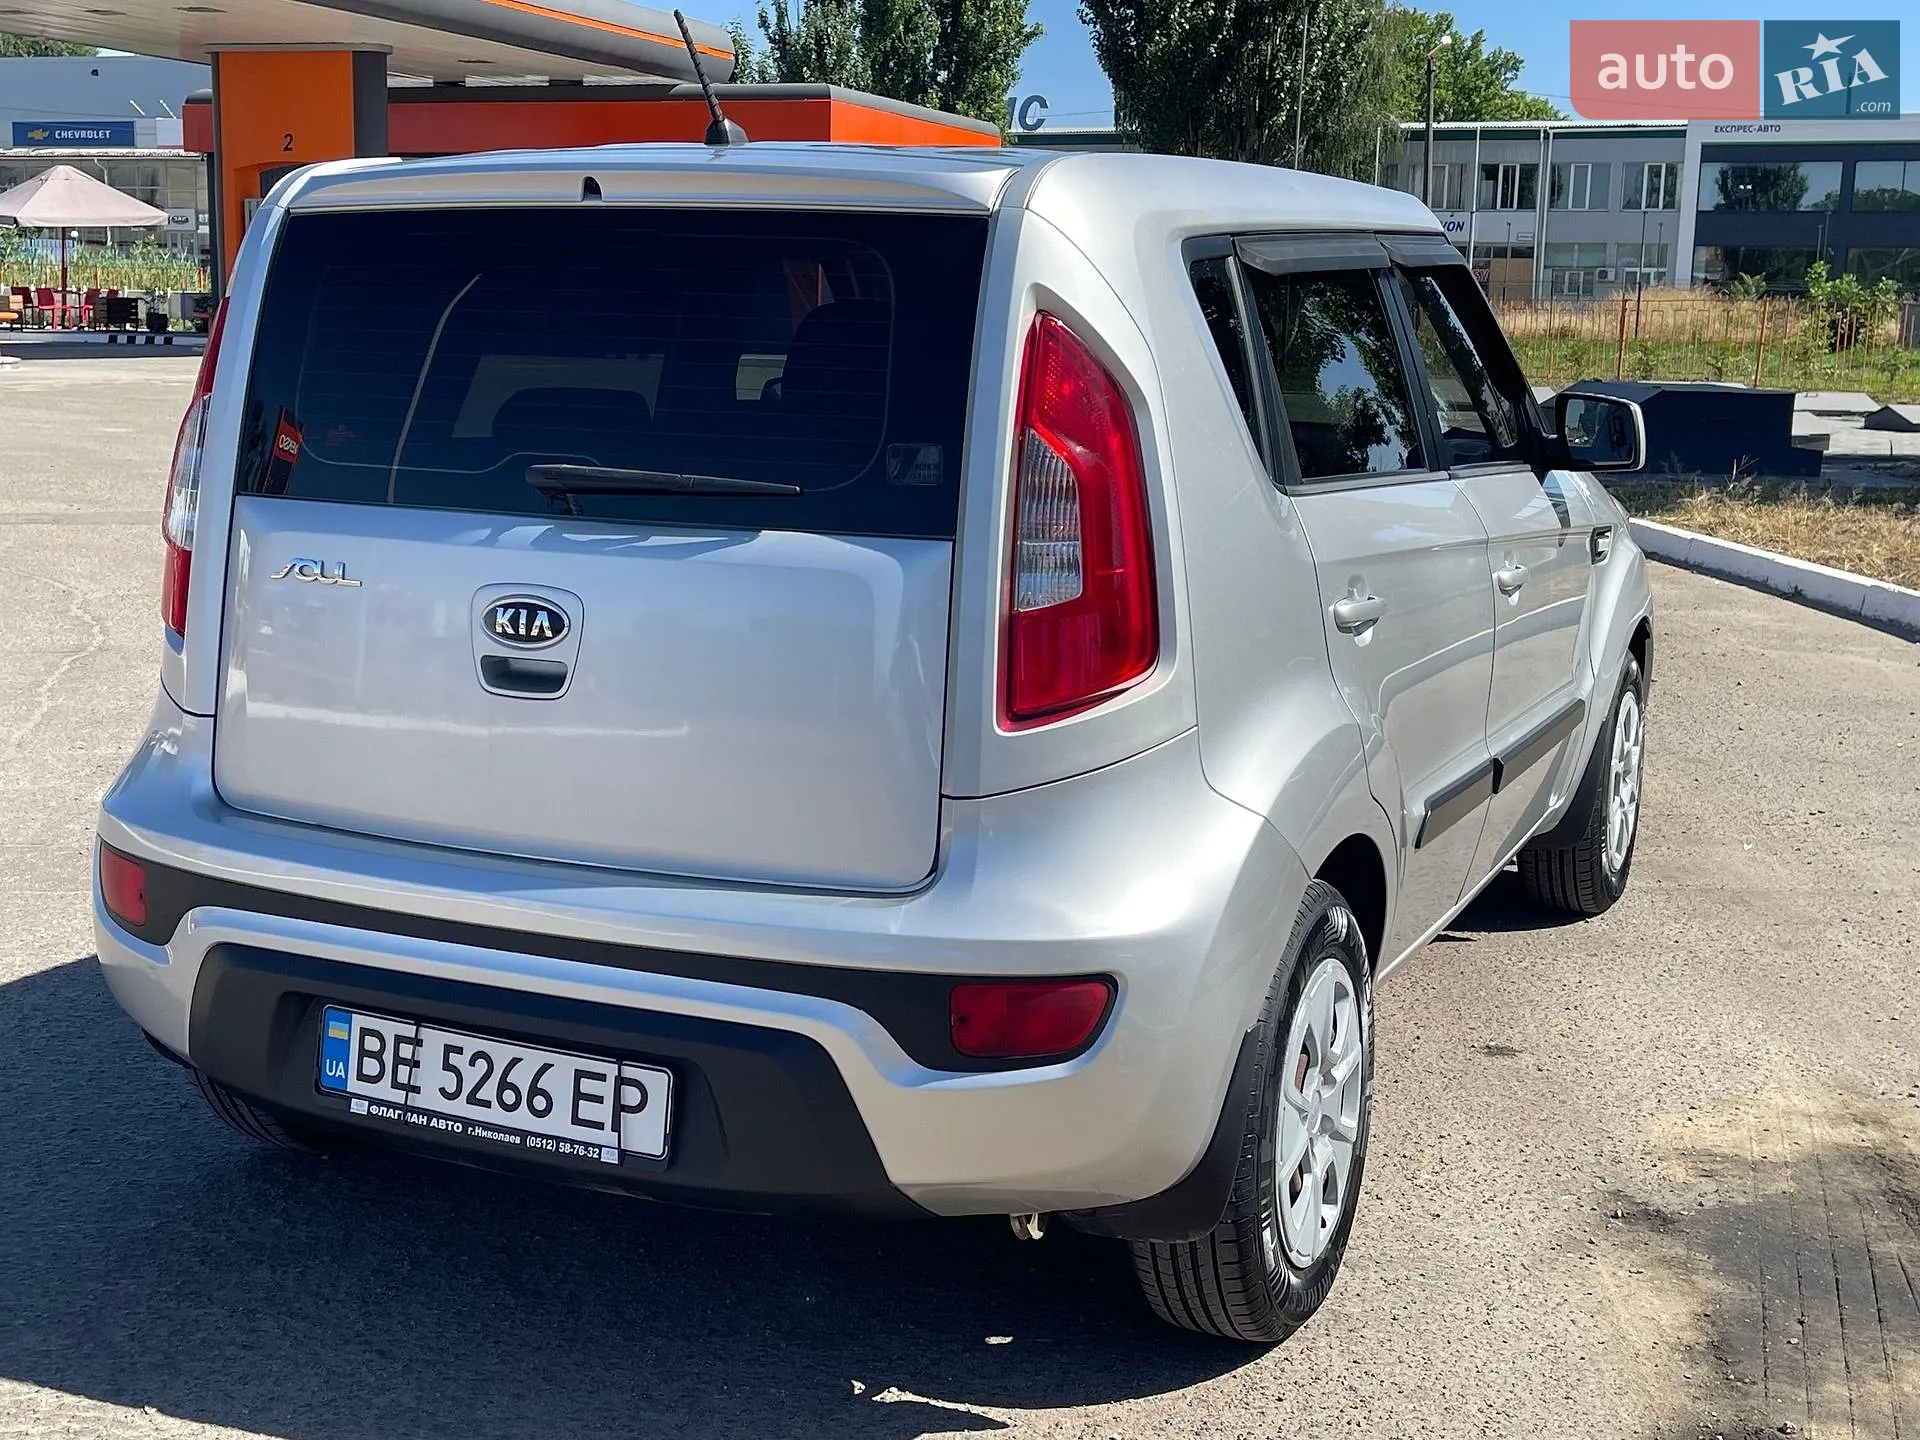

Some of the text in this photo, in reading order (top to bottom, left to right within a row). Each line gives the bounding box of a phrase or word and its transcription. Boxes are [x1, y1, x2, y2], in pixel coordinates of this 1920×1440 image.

[55, 130, 112, 139] CHEVROLET
[283, 132, 294, 152] 2
[270, 557, 362, 587] SOUL
[495, 607, 553, 637] KIA
[325, 1058, 346, 1079] UA
[356, 1026, 649, 1133] BE 5266 EP
[429, 1117, 463, 1133] АВТО
[467, 1125, 521, 1145] г.Николаев
[526, 1134, 557, 1151] (0512)
[558, 1140, 600, 1158] 58-76-32
